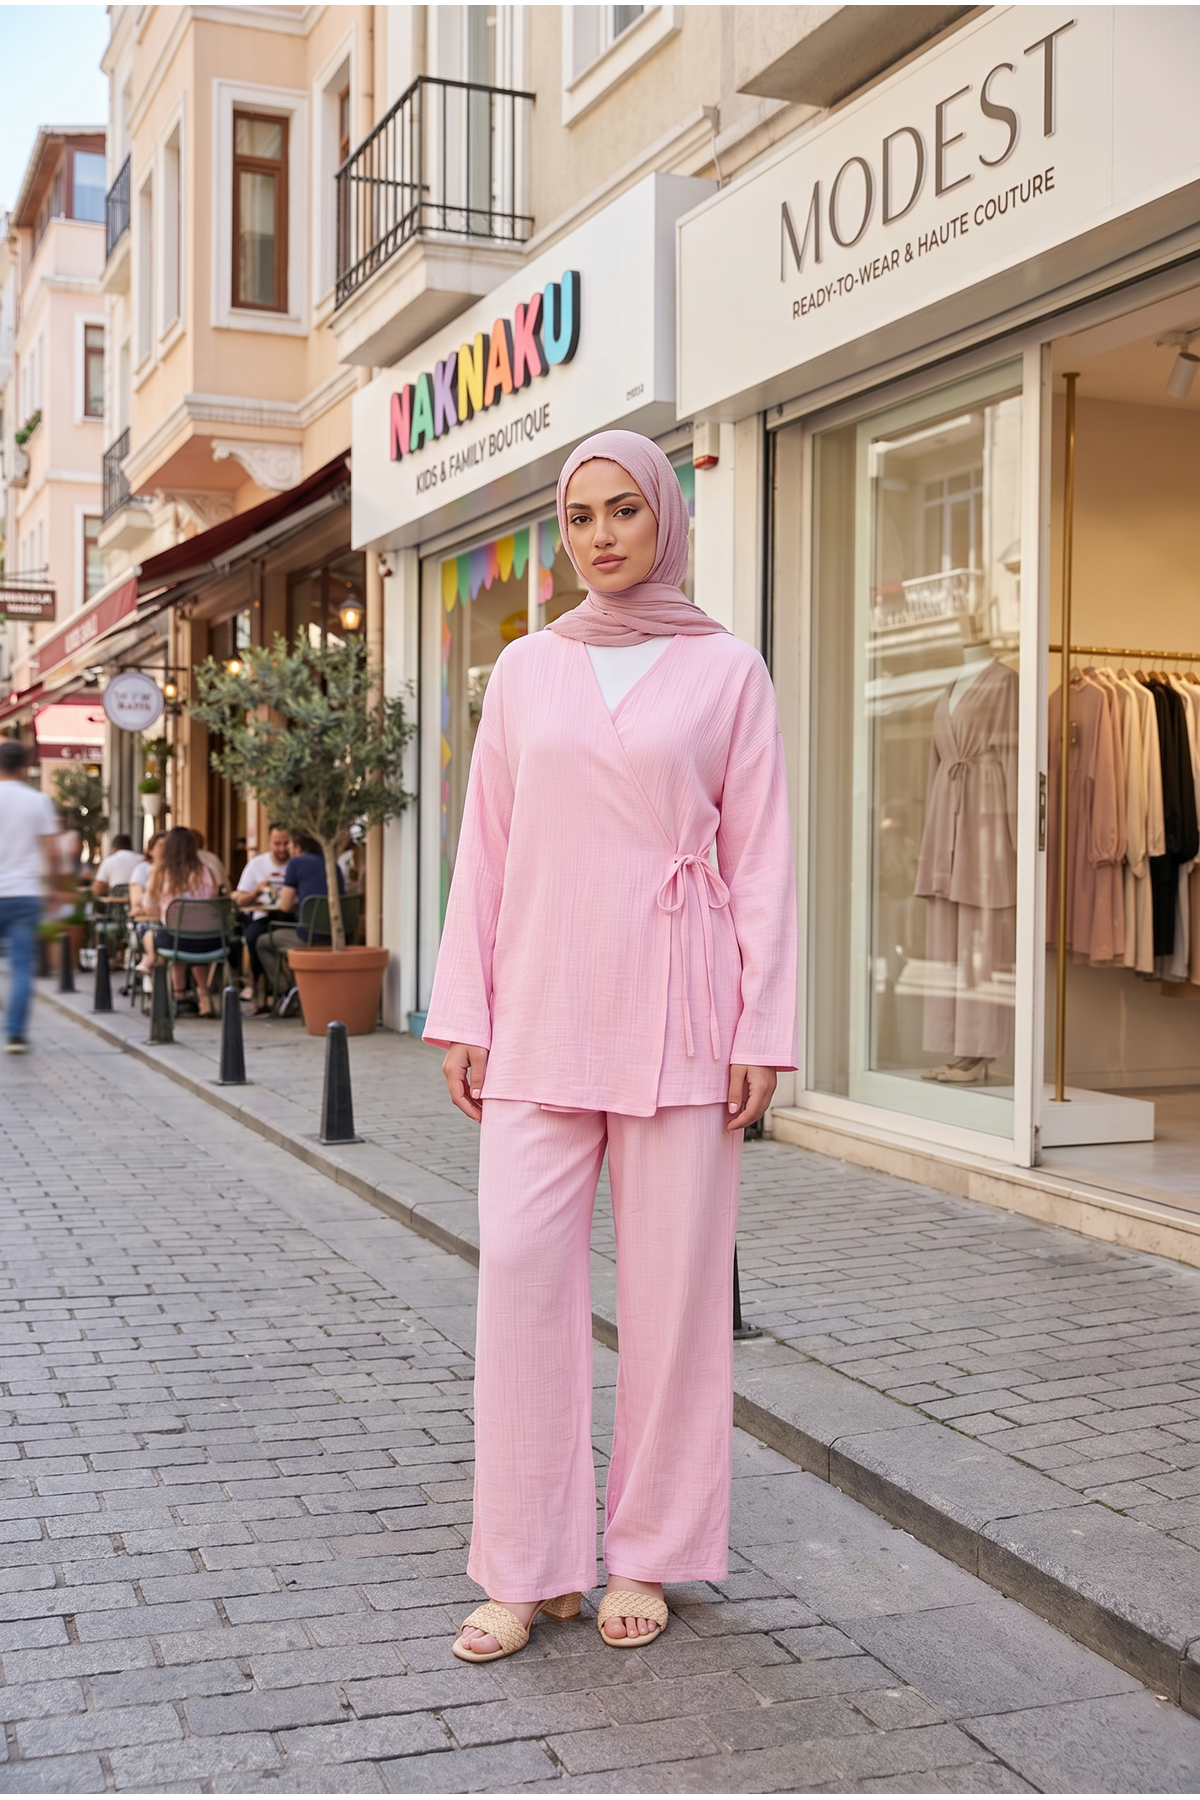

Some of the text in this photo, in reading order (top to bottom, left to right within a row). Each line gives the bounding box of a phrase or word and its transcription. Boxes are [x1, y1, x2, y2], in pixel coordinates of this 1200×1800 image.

[780, 18, 1078, 283] MODEST
[792, 167, 1056, 320] READY-TO-WEAR & HAUTE COUTURE
[390, 269, 581, 462] NAKNAKU
[416, 402, 551, 496] KIDS & FAMILY BOUTIQUE
